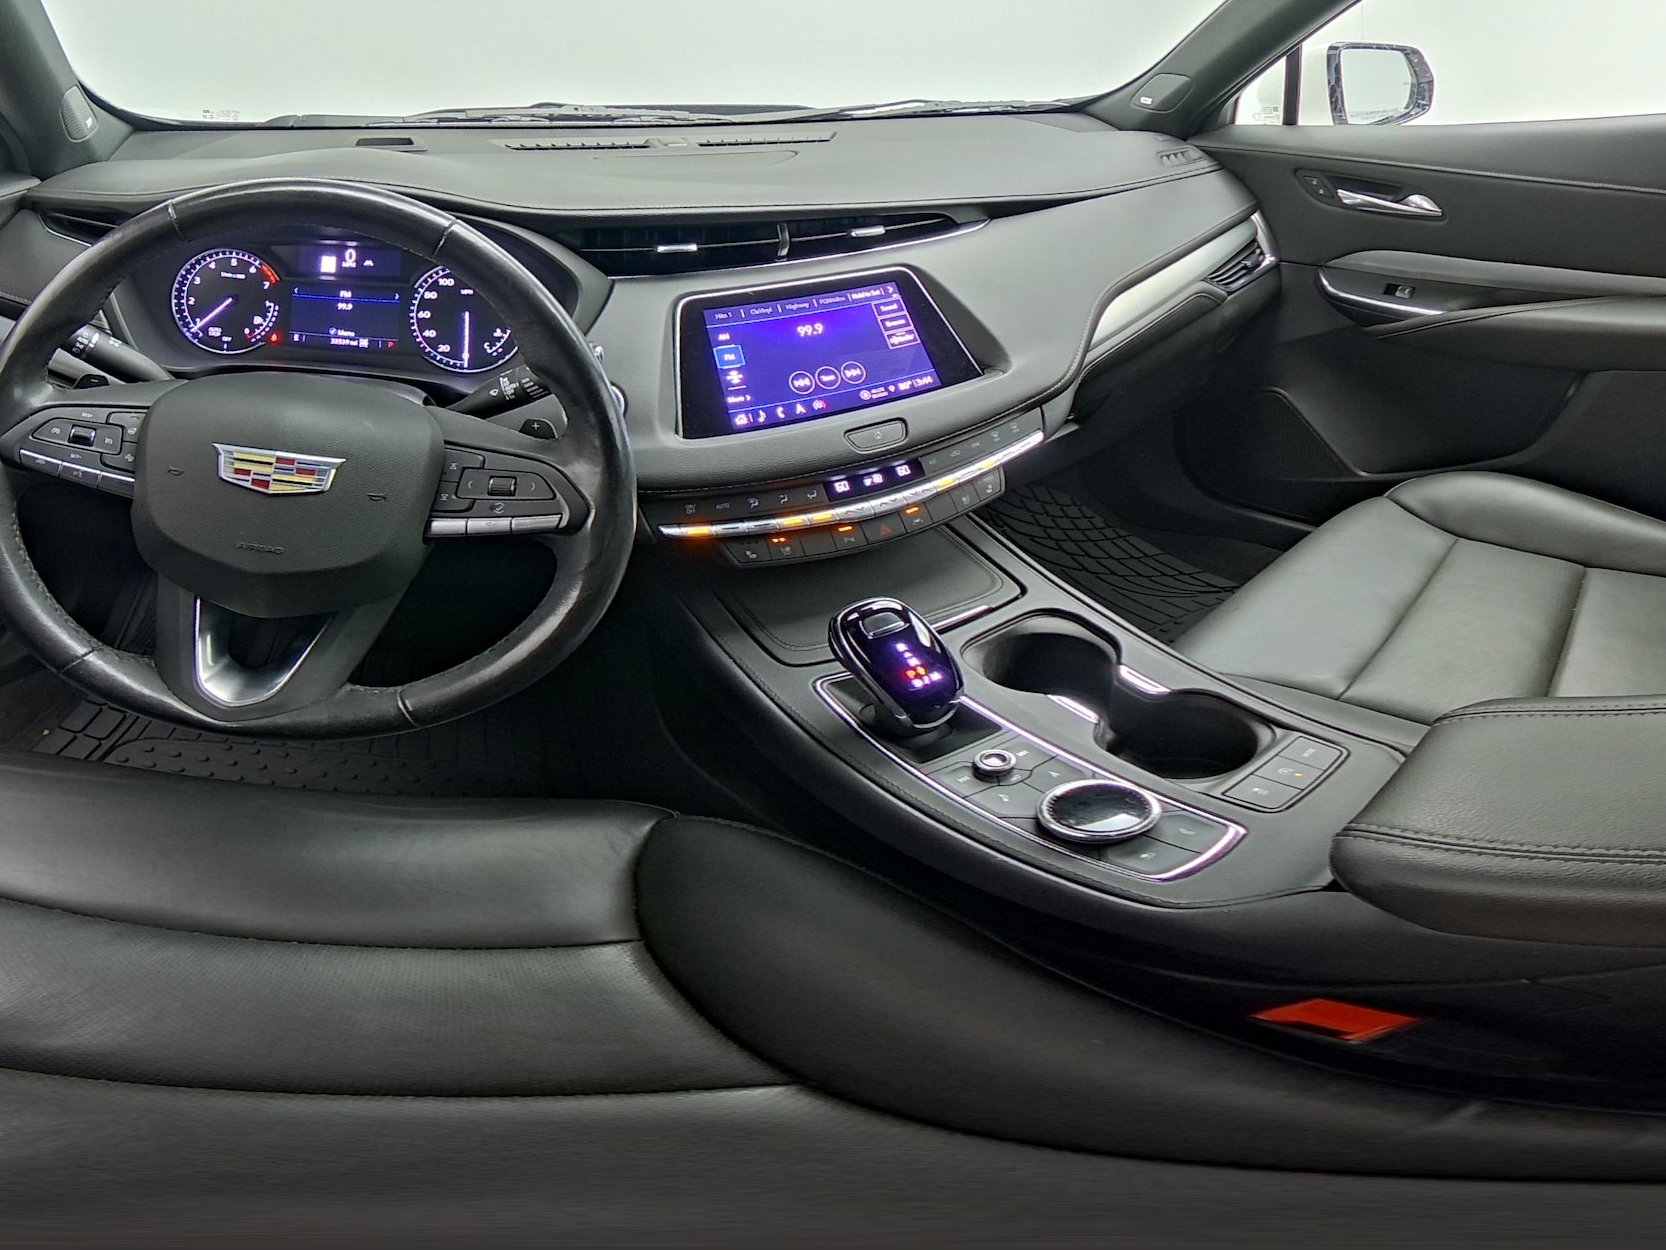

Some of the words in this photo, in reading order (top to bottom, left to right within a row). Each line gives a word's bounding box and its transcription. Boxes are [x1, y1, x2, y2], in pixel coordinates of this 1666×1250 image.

[345, 249, 356, 262] 0
[438, 278, 454, 286] 100
[424, 291, 437, 299] 80
[188, 297, 195, 305] 2
[785, 302, 809, 310] Highway
[797, 323, 823, 337] 99.9
